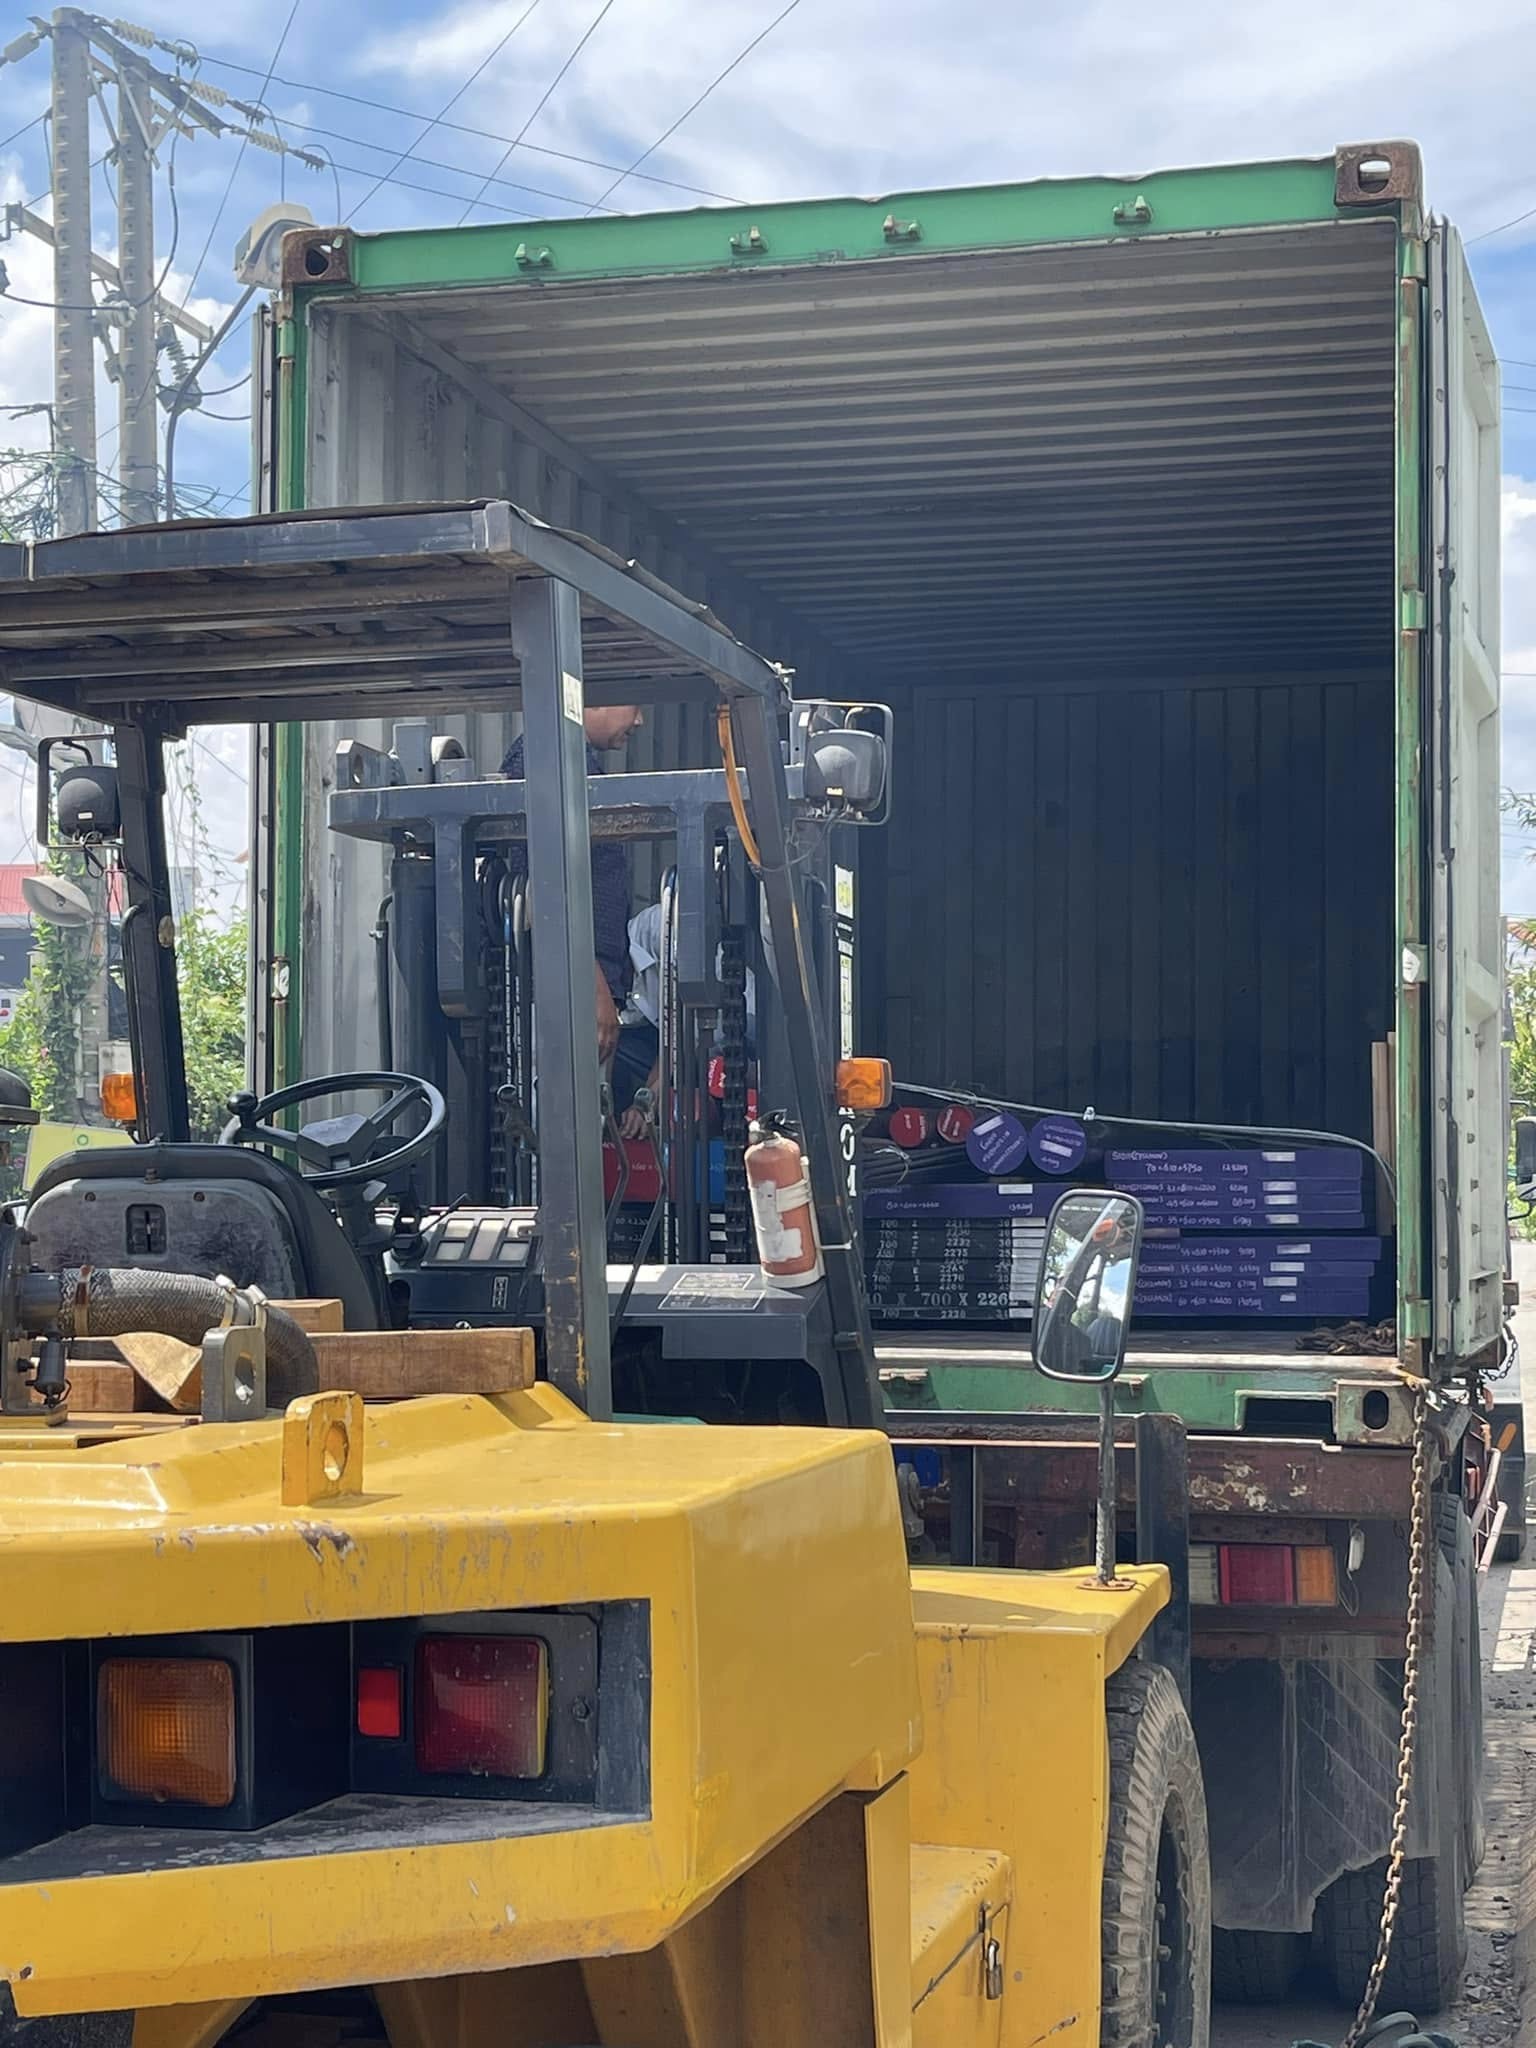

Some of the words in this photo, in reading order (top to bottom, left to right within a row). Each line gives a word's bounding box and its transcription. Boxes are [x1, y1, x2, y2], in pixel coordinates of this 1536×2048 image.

[920, 1292, 952, 1306] 700
[958, 1292, 969, 1306] X
[977, 1292, 1019, 1306] 226
